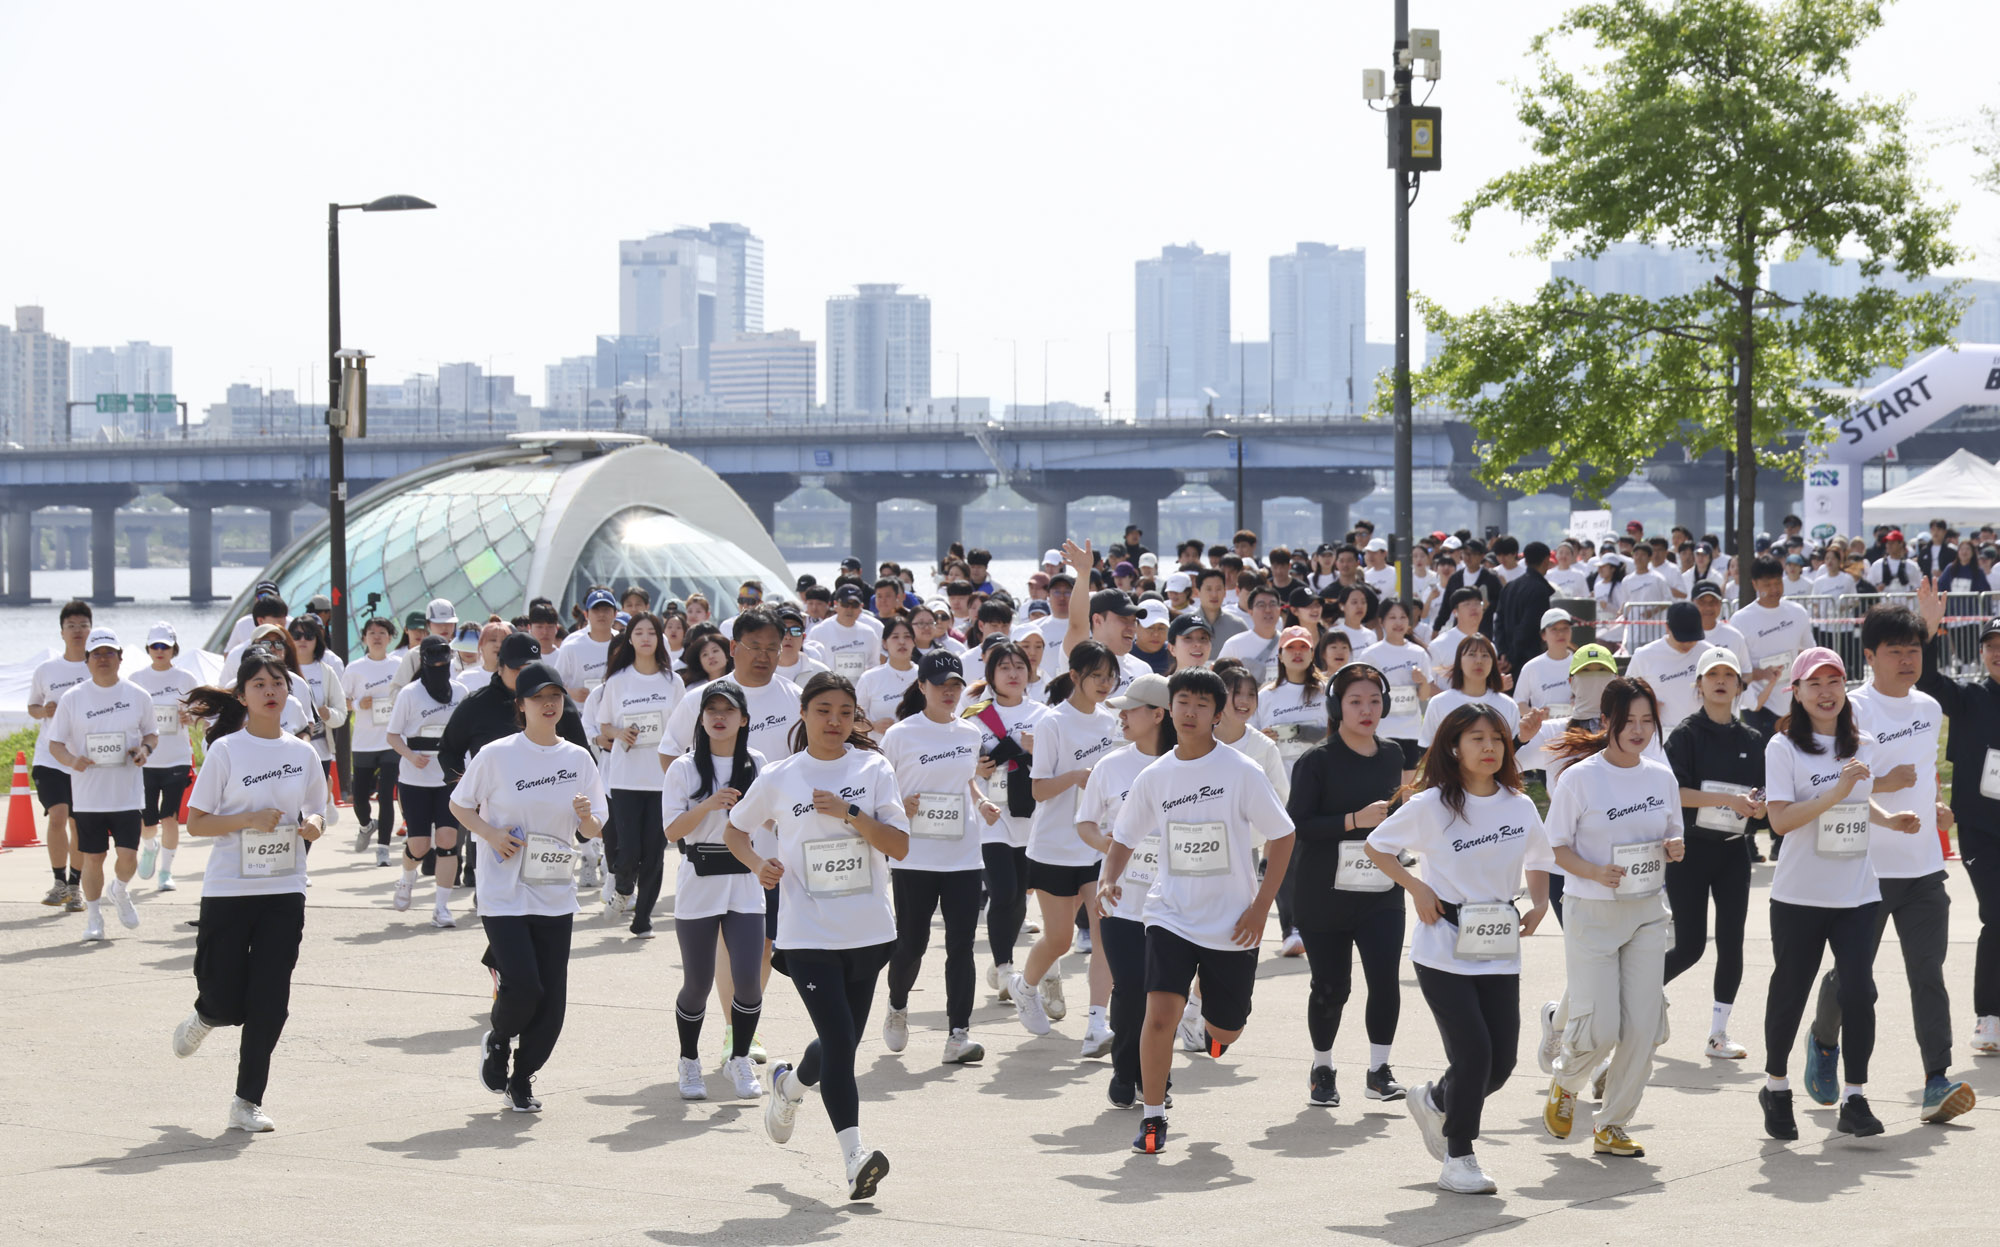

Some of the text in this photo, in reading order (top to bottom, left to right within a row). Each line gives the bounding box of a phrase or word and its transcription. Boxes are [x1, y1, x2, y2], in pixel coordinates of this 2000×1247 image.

[1841, 375, 1932, 445] START
[583, 661, 607, 672] Burnin
[935, 658, 960, 670] NYC
[1659, 669, 1687, 683] Burning
[622, 693, 667, 708] Burning Run
[86, 701, 131, 720] Burning Run
[1273, 705, 1302, 718] Burning
[765, 715, 787, 727] Run
[1014, 722, 1033, 733] Run
[639, 724, 659, 734] 276
[1876, 720, 1931, 744] Burning Run
[97, 744, 122, 754] 5005
[919, 745, 972, 765] Burning Run
[1074, 743, 1102, 760] Burning
[242, 763, 303, 787] Burning Run
[515, 769, 578, 791] Burning Run
[1810, 771, 1840, 786] Burni
[839, 786, 867, 800] Run
[1199, 786, 1225, 799] Run
[927, 809, 959, 820] 6328
[1606, 796, 1665, 820] Burning Run
[1824, 821, 1867, 834] W 6198
[1452, 825, 1525, 852] Burning Run
[247, 842, 291, 855] W 6224
[1174, 840, 1220, 854] M 5220
[531, 852, 572, 864] W 6352
[1133, 852, 1143, 861] W
[812, 856, 863, 873] W 6231
[1345, 859, 1379, 869] W 63
[1631, 859, 1661, 875] 6288
[1131, 871, 1149, 880] D-65
[1466, 923, 1512, 936] W 6326
